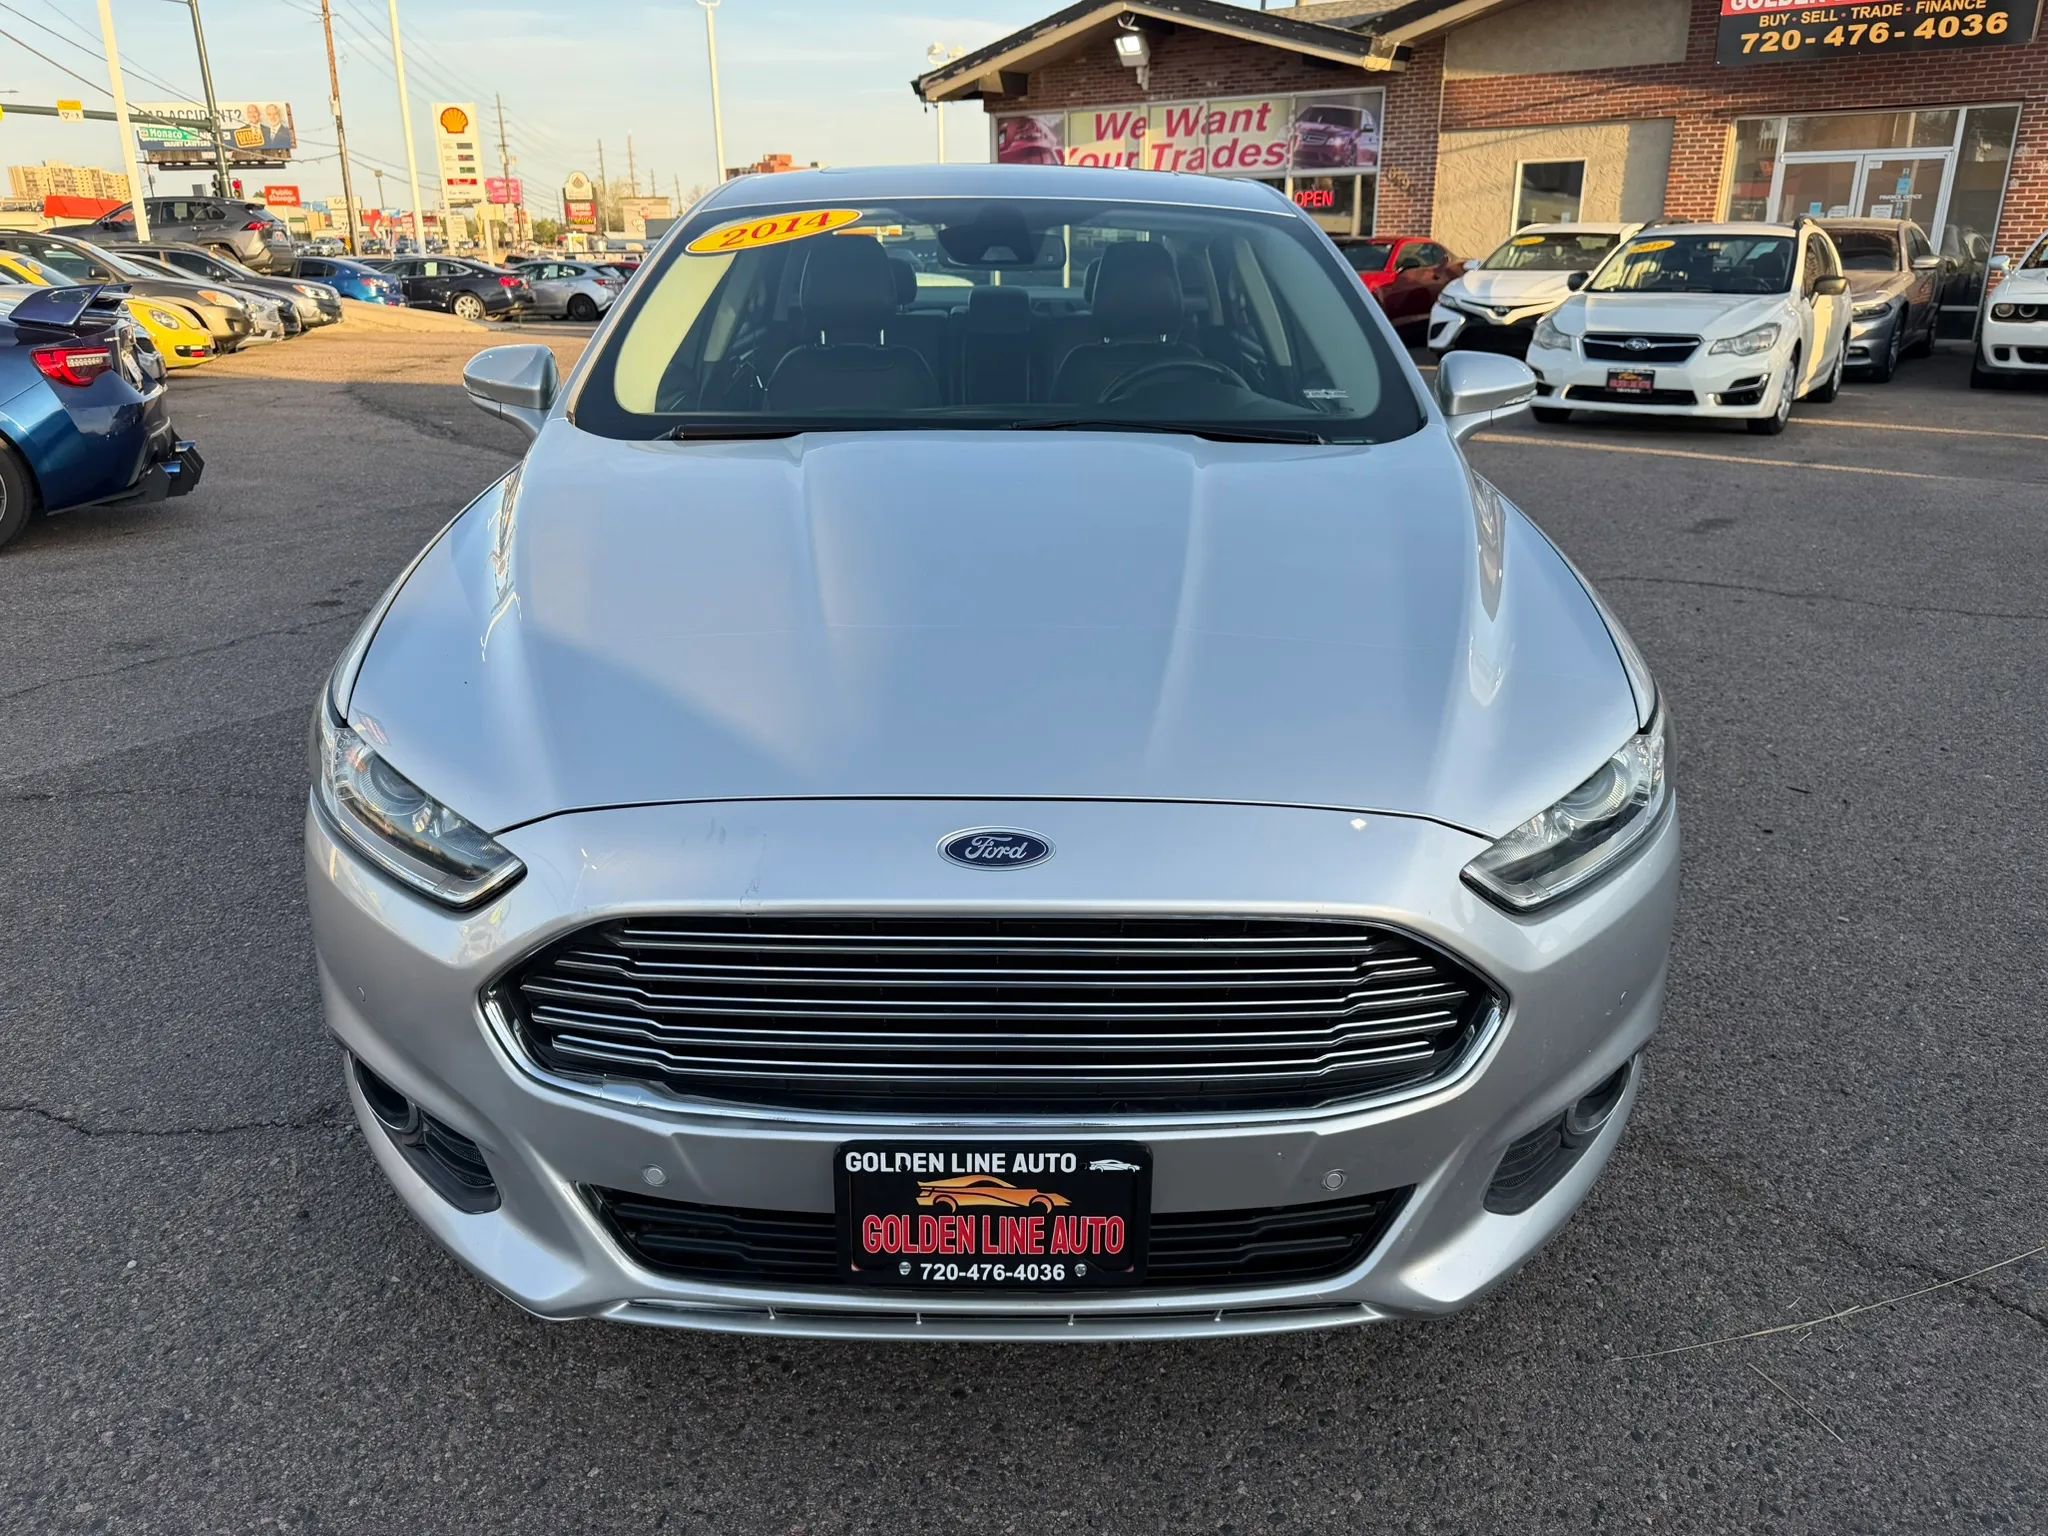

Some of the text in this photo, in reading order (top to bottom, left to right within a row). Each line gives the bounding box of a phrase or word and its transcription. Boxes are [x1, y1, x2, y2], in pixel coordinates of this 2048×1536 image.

[1759, 0, 1987, 28] BUY SELL TRADE FINANCE
[148, 128, 183, 139] Monaco
[1094, 102, 1271, 141] We Want
[1295, 190, 1334, 208] OPEN
[718, 211, 833, 248] 2014
[964, 835, 1028, 859] Ford
[845, 1152, 1077, 1173] GOLDEN LINE AUTO
[862, 1214, 1125, 1255] GOLDEN LINE AUTO
[920, 1263, 1066, 1281] 720-476-4036
